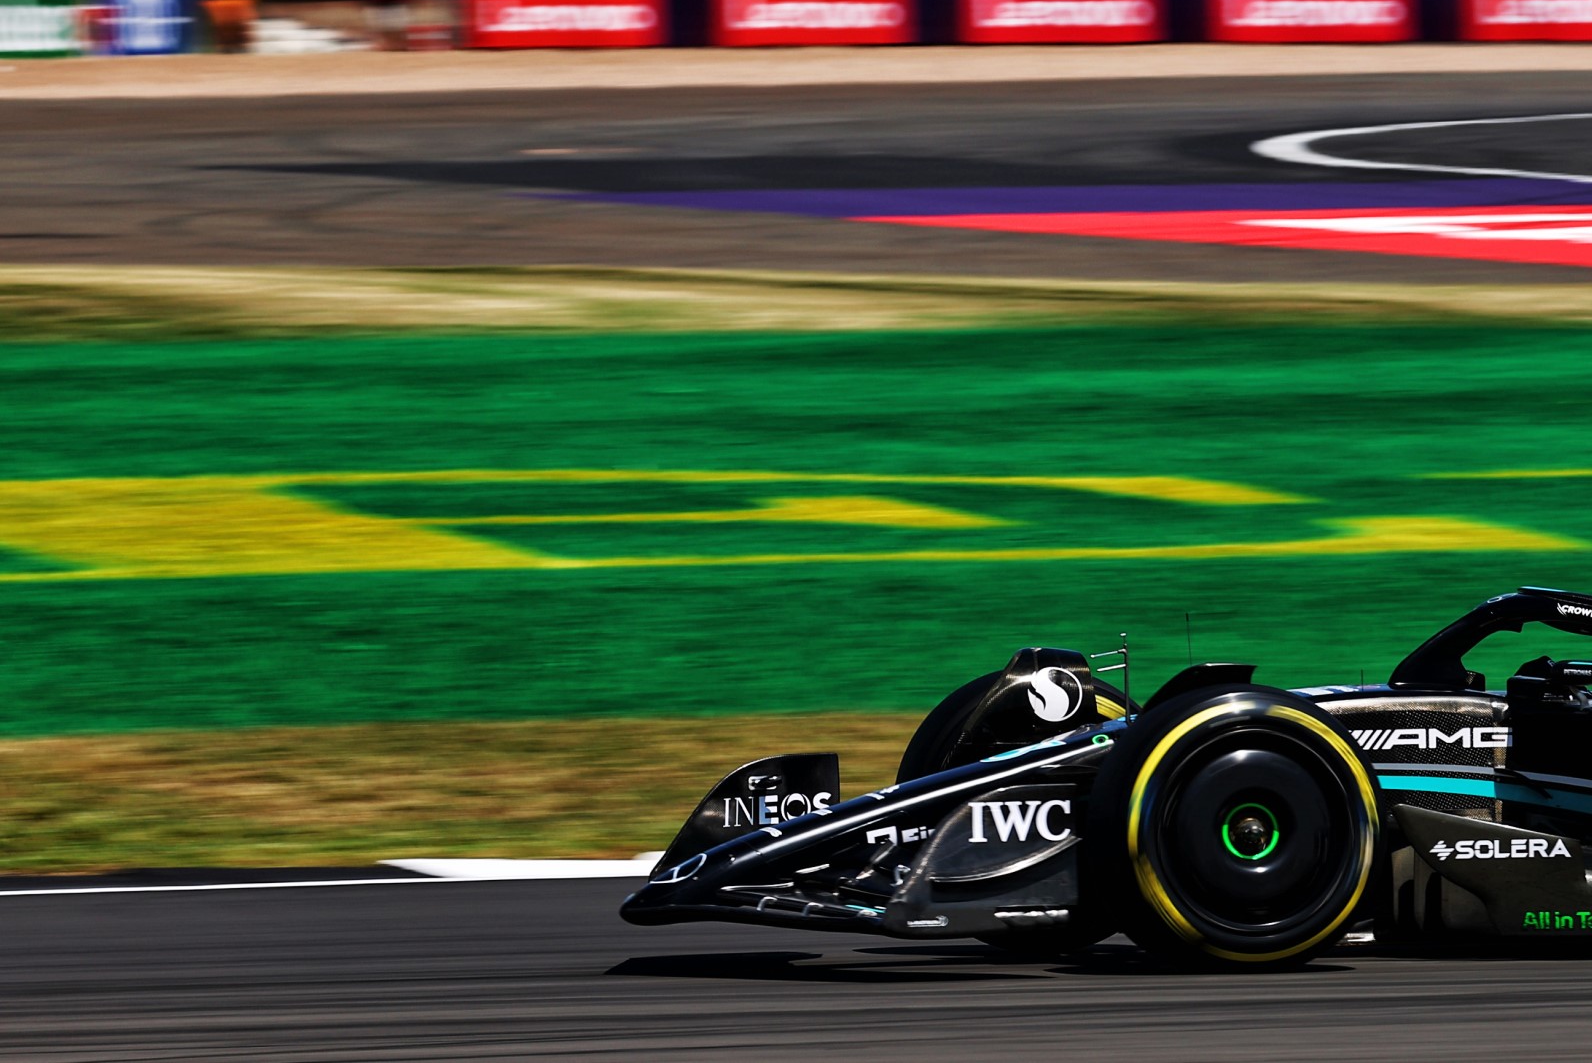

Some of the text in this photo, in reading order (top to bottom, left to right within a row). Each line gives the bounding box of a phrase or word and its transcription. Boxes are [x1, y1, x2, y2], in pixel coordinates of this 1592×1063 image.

[1381, 726, 1514, 750] AMG
[722, 791, 832, 828] INEOS
[968, 799, 1072, 843] IWC
[1455, 838, 1572, 860] SOLERA
[1523, 911, 1550, 930] All
[1555, 911, 1574, 930] in
